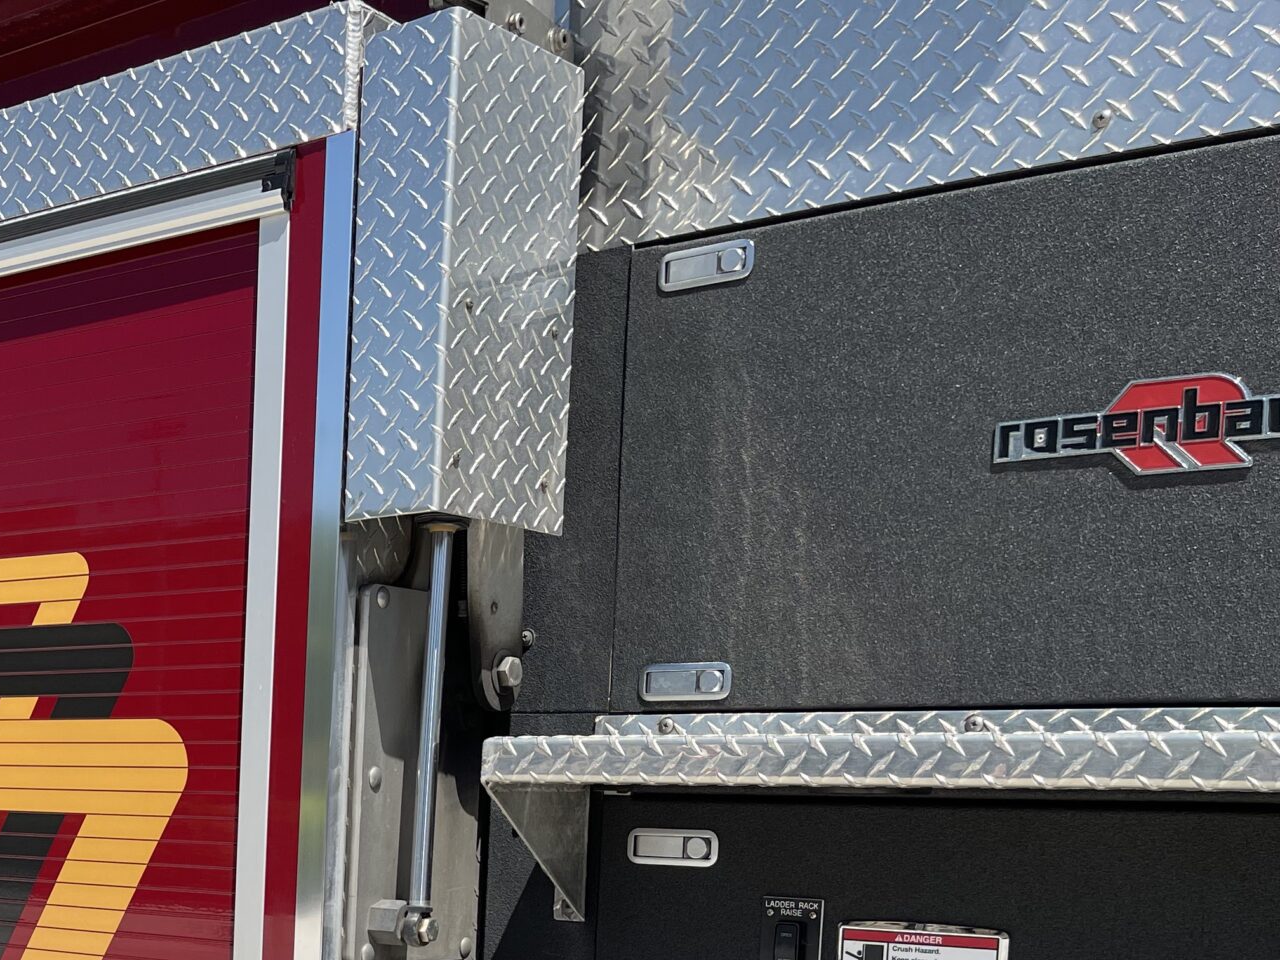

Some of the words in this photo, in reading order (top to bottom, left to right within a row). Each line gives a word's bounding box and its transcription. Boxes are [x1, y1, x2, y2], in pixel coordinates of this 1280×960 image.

[995, 385, 1280, 462] rosenba
[765, 900, 796, 909] LADDER
[798, 902, 819, 910] RACK
[780, 908, 803, 917] RAISE
[903, 934, 943, 945] DANGER
[892, 945, 913, 953] Crush
[914, 947, 941, 955] Hazard.
